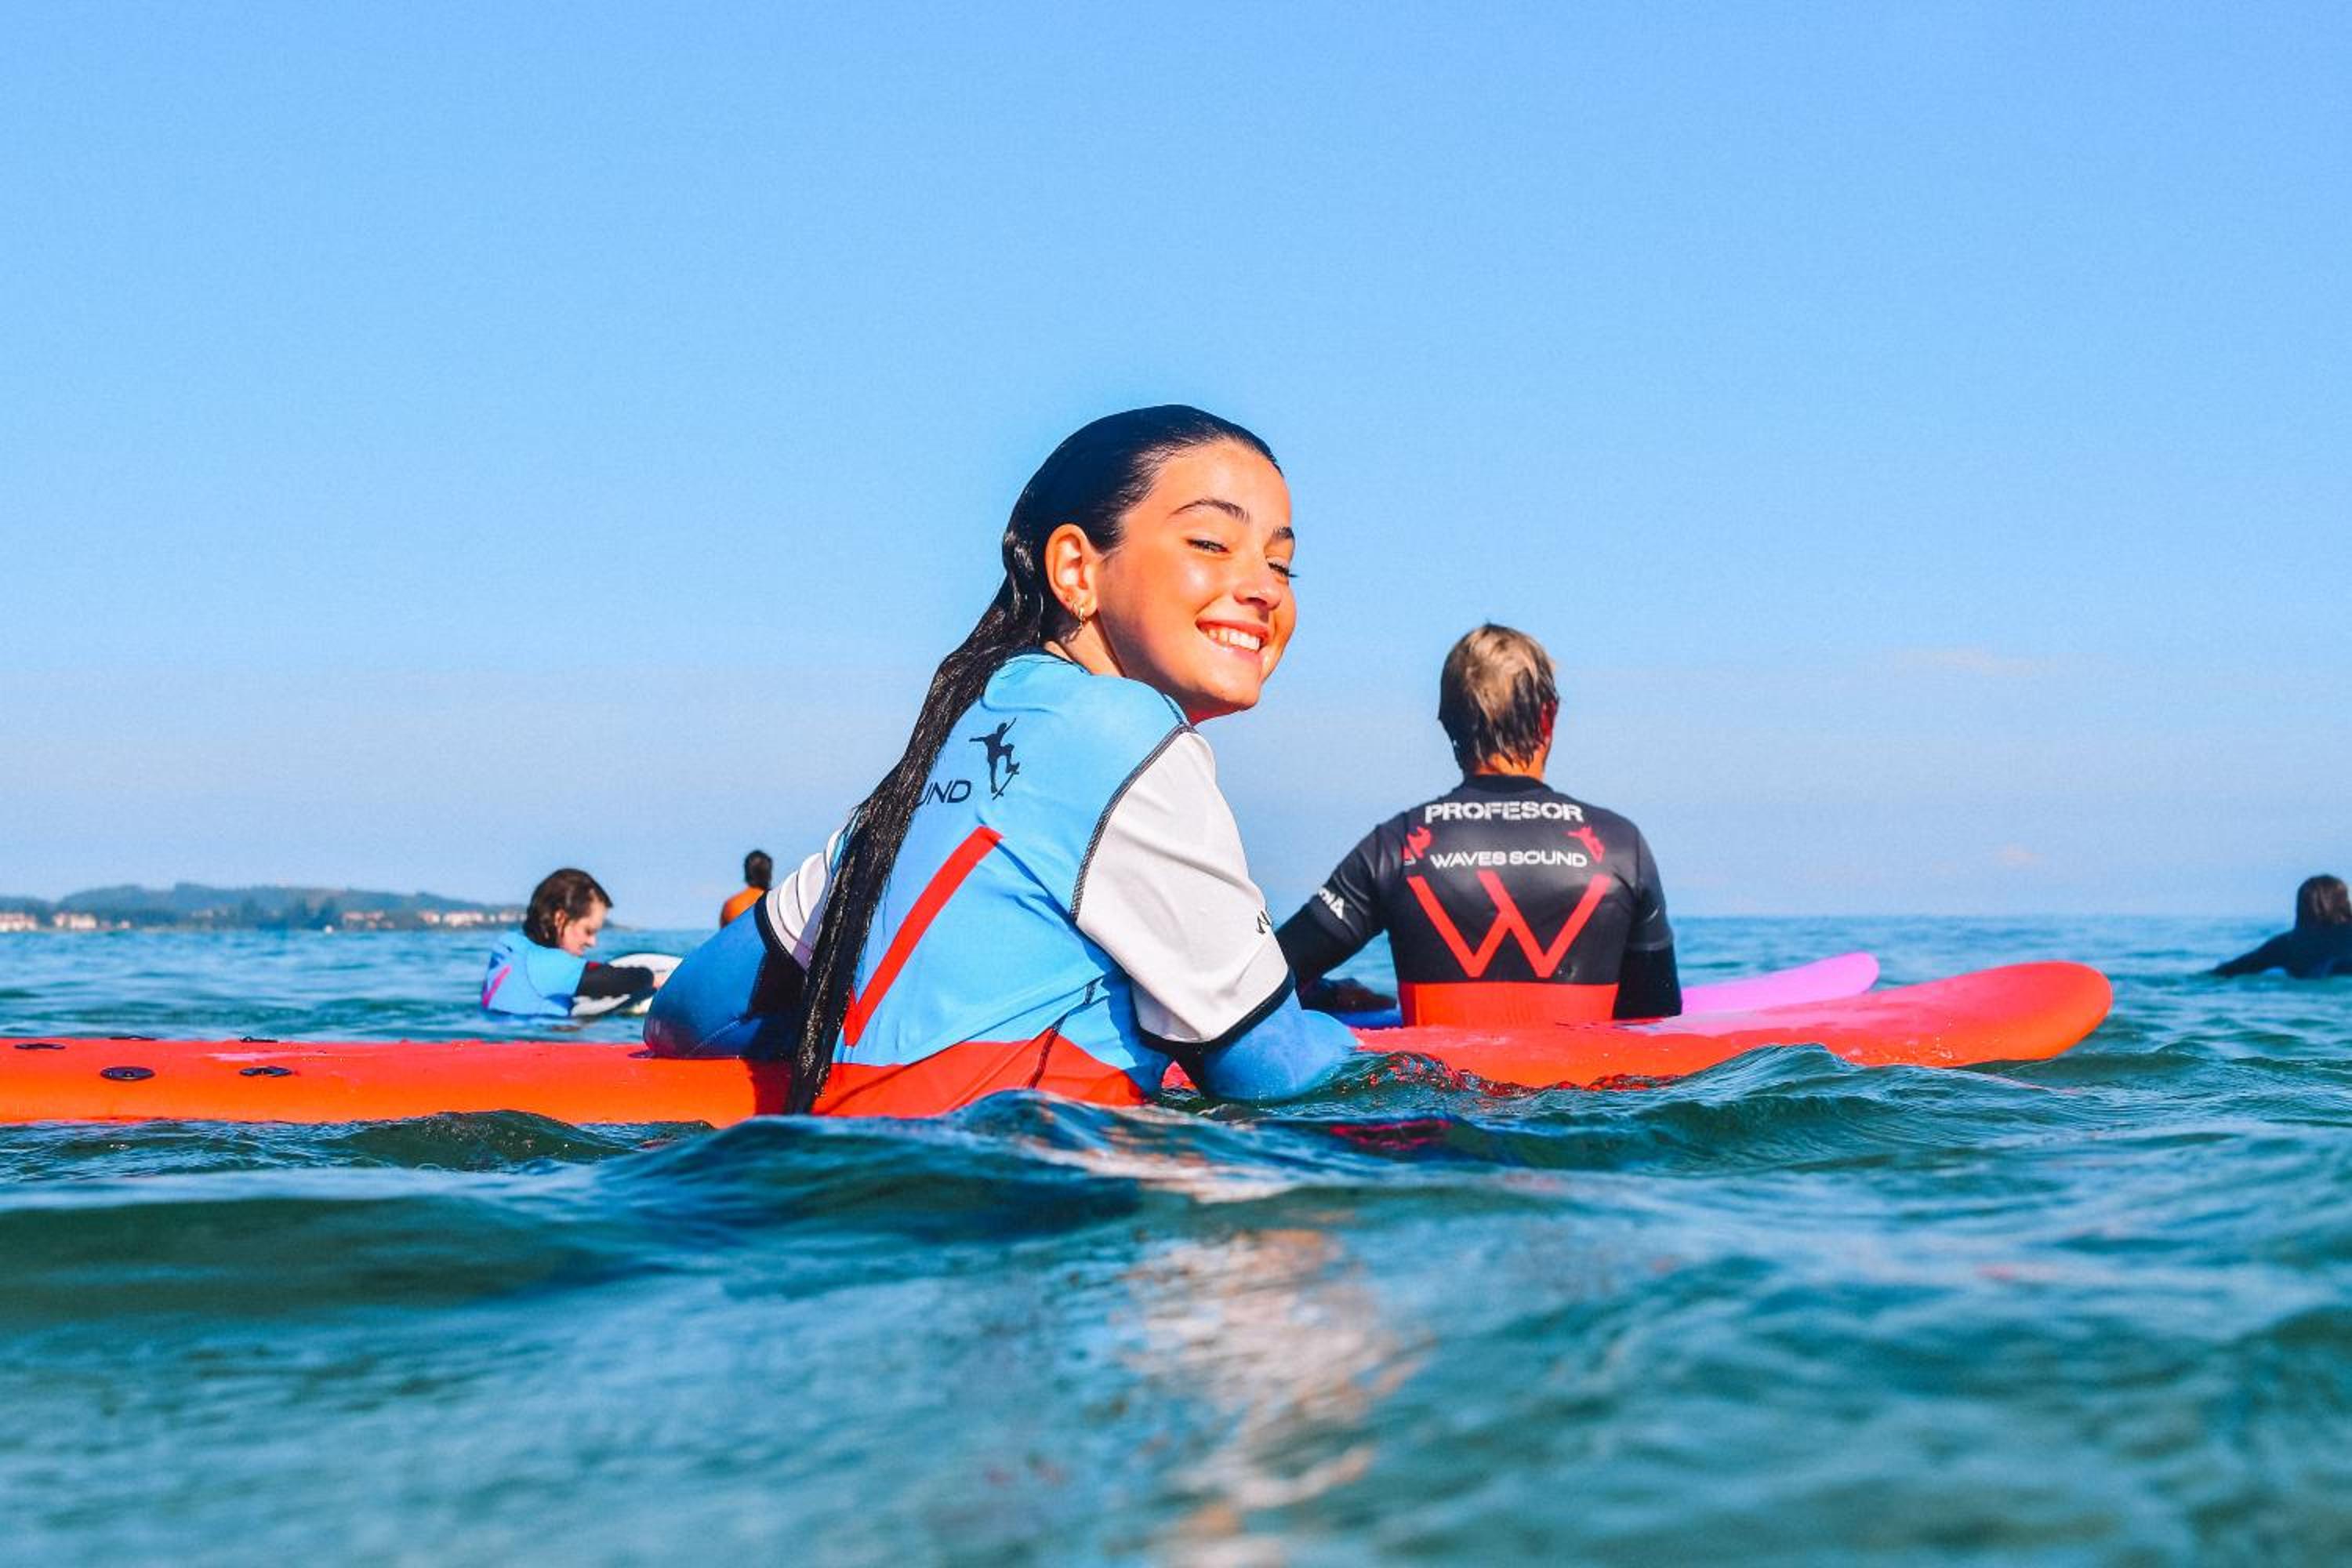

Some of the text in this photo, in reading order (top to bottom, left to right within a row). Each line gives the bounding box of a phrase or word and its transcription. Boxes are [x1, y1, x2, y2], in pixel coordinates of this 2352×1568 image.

[1425, 801, 1584, 823] PROFESOR
[1430, 850, 1588, 869] WAVES SOUND
[1406, 869, 1611, 978] W
